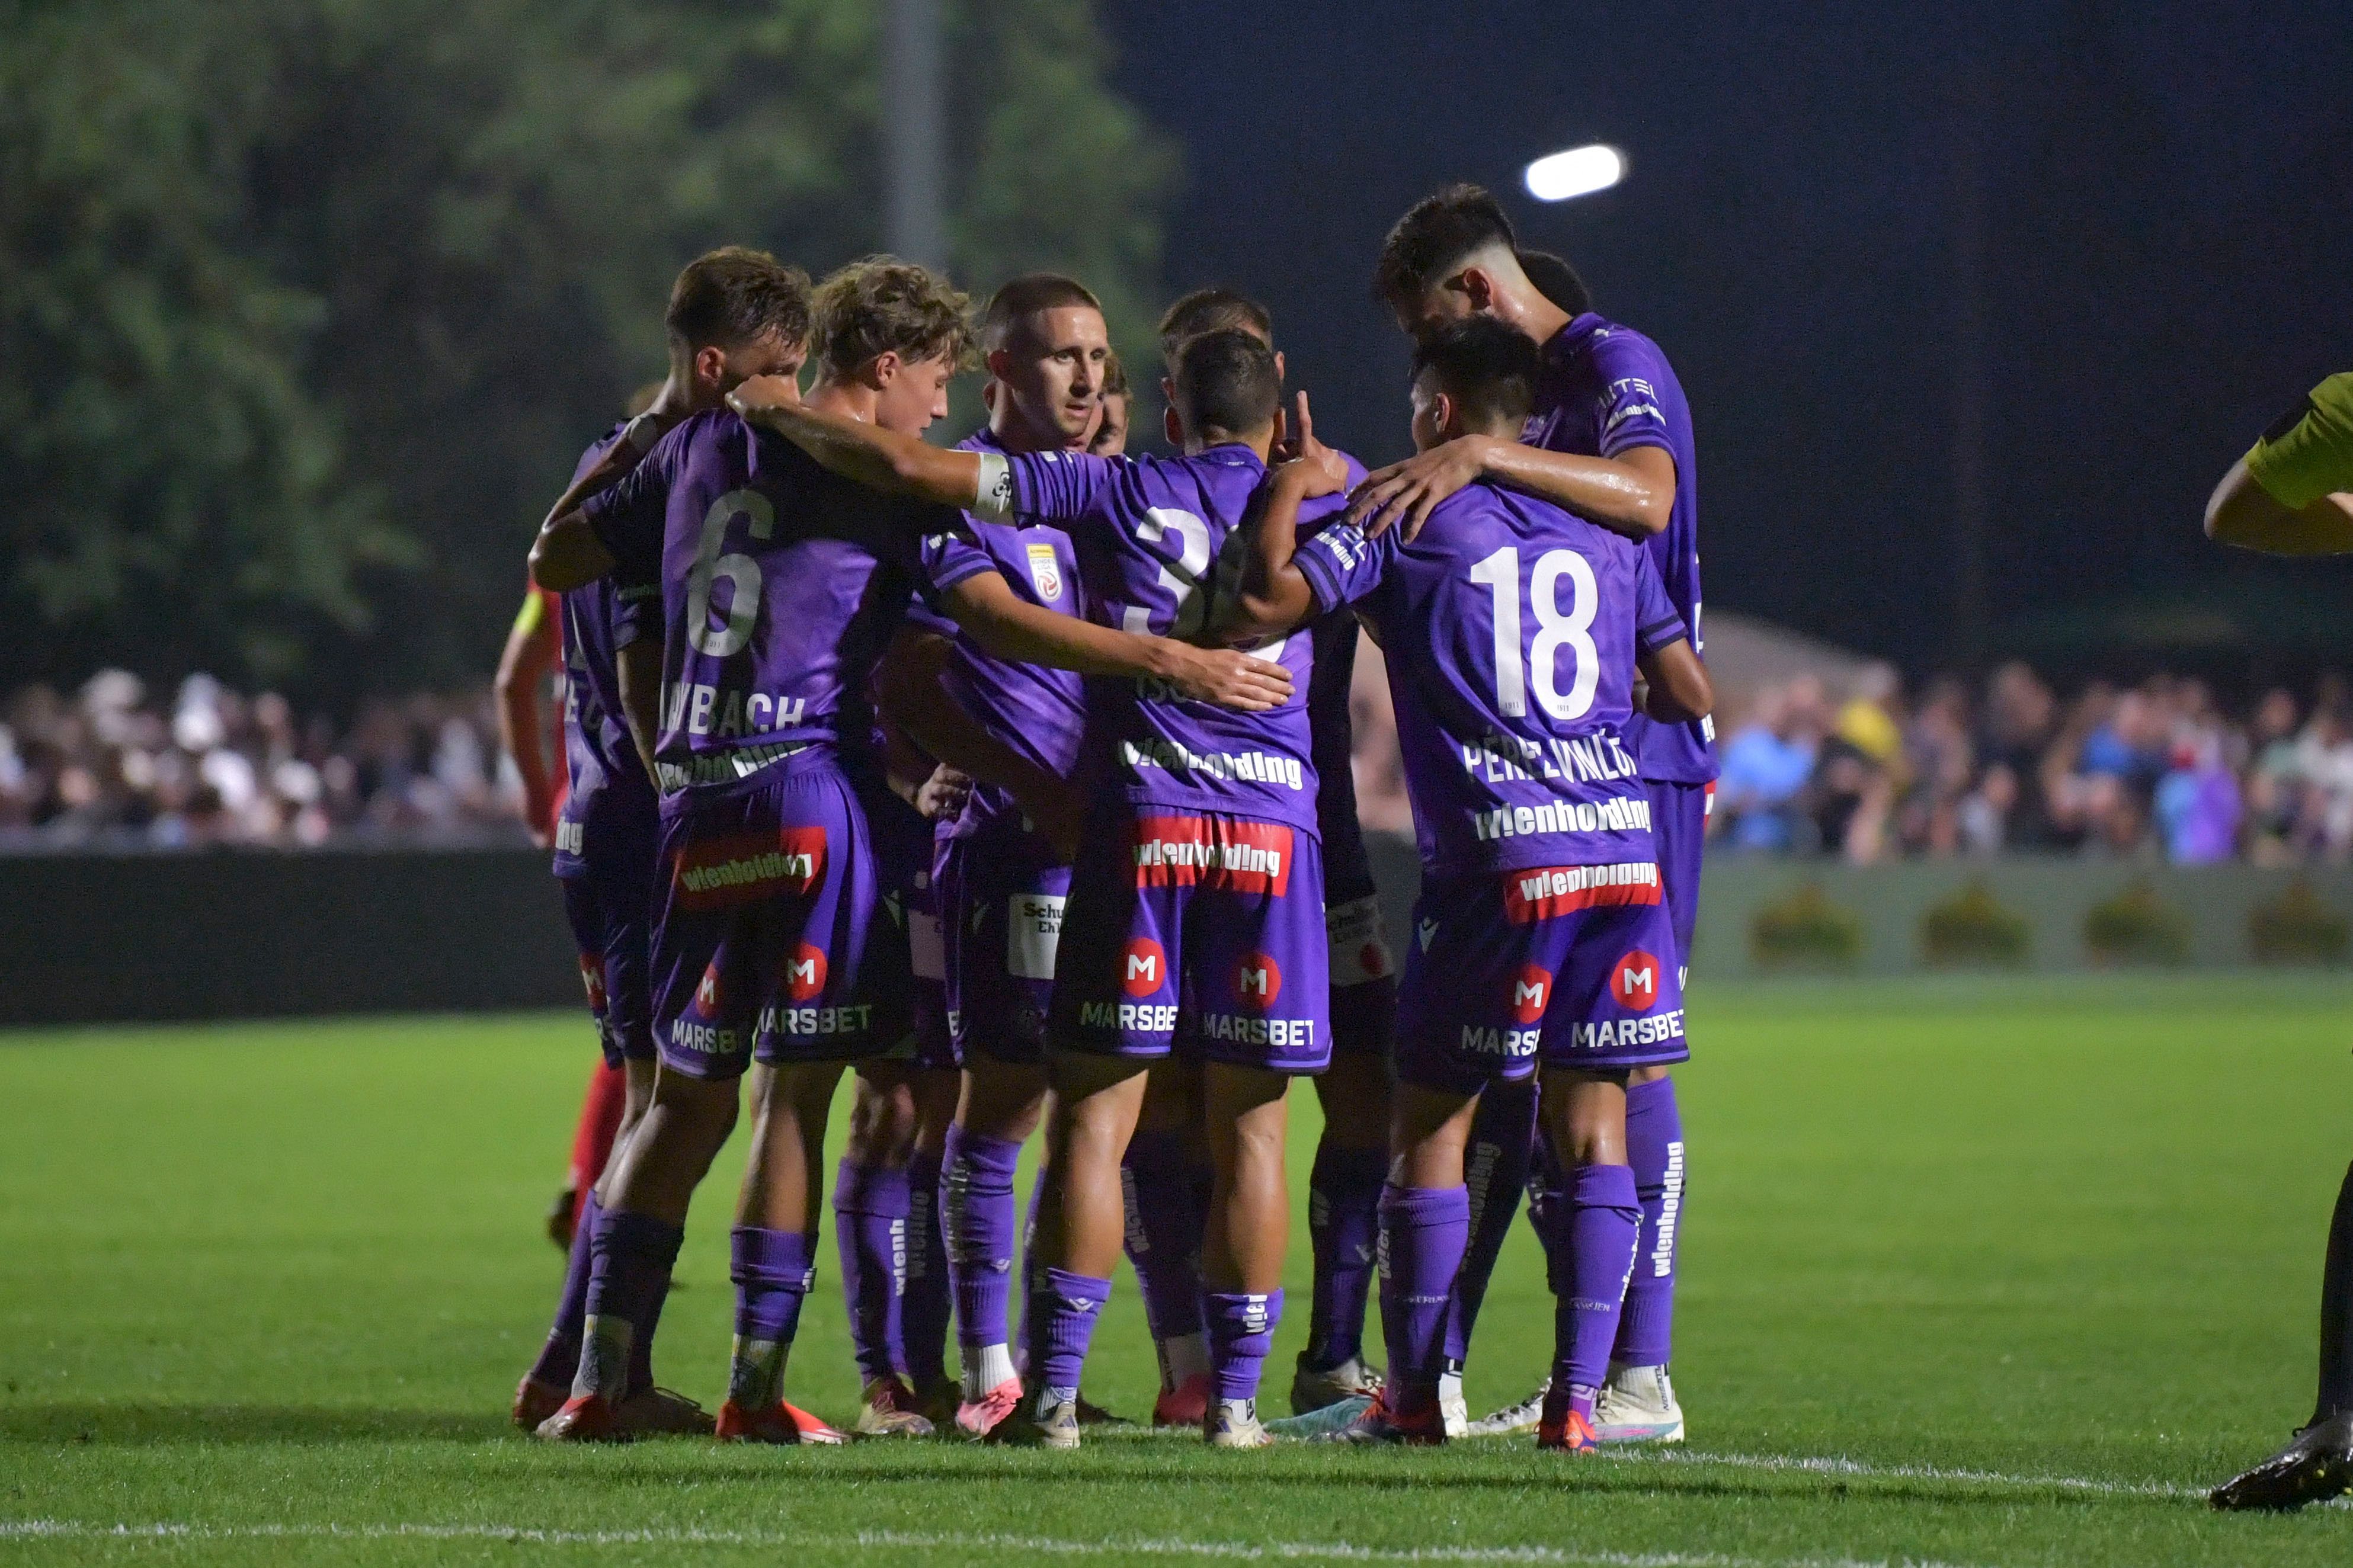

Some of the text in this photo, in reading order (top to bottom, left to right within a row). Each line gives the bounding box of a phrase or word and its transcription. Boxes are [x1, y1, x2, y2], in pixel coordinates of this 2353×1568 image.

[687, 489, 774, 656] 6
[1470, 546, 1599, 720] 18
[787, 958, 814, 985] M
[1128, 954, 1155, 981] M
[1241, 967, 1267, 995] M
[1624, 967, 1652, 994] M
[700, 976, 714, 1004] M
[1515, 980, 1544, 1008] M
[1203, 1013, 1314, 1046] MARSBET
